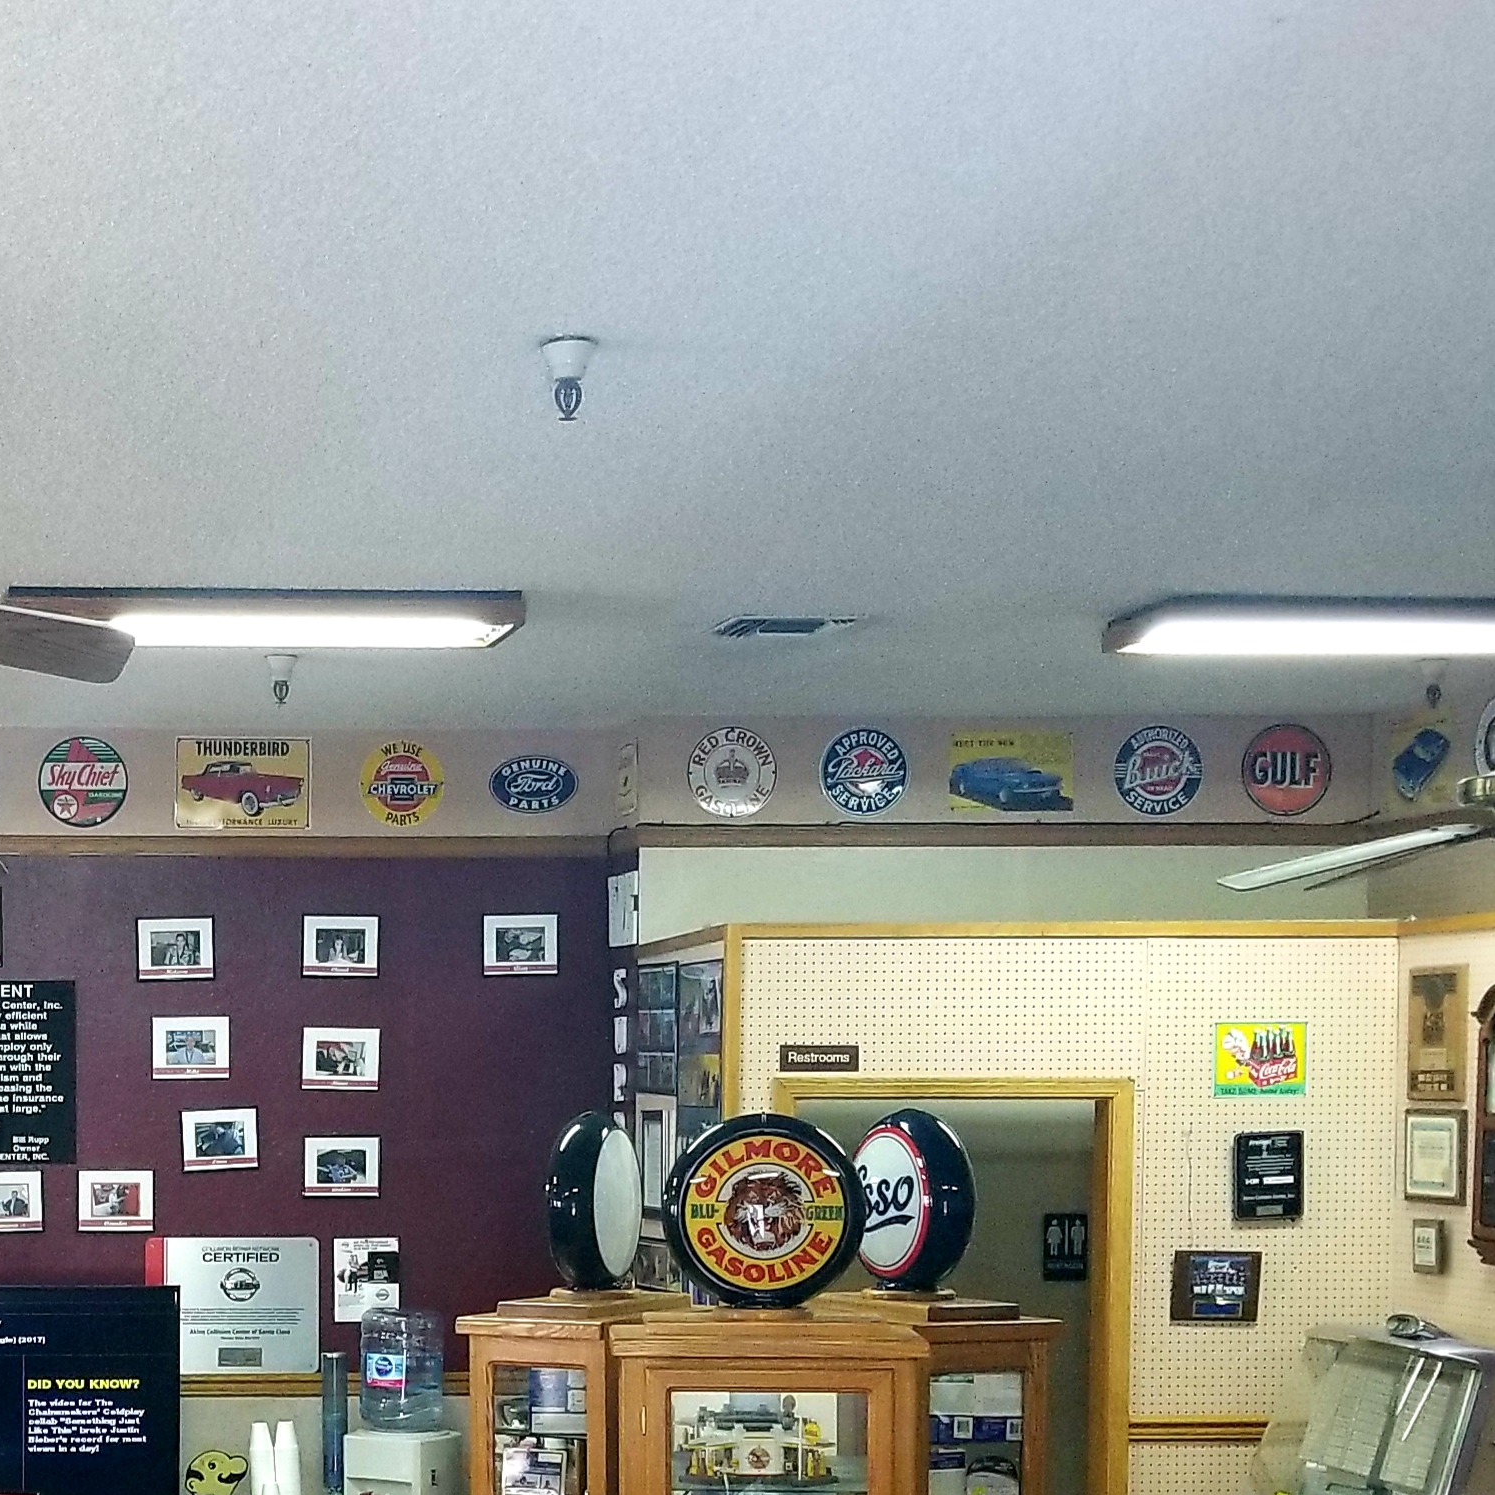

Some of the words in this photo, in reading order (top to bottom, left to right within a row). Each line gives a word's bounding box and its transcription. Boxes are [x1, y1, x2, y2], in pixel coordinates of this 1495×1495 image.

[834, 731, 900, 760] APPROVED
[1131, 727, 1189, 750] AUTHORIZED
[195, 741, 290, 757] THUNDERBIRD
[380, 743, 399, 757] WE
[401, 741, 423, 757] USE
[692, 736, 719, 767] RED
[725, 729, 773, 768] CROWN
[379, 760, 424, 774] Genuine
[501, 758, 569, 777] GENUINE
[827, 754, 905, 784] Packard
[1124, 750, 1198, 789] Buick
[1254, 751, 1320, 788] GULF
[46, 764, 74, 791] Sky
[76, 763, 120, 788] Chief
[510, 772, 558, 794] Ford
[87, 791, 124, 799] GASOLINE
[369, 783, 437, 796] CHEVROLET
[508, 796, 560, 811] PARTS
[695, 784, 771, 816] GASOLINE
[829, 783, 904, 813] SERVICE
[1125, 791, 1189, 814] SERVICE
[268, 818, 298, 826] LUXURY
[385, 811, 421, 827] PARTS
[1, 1000, 40, 1012] Center,
[5, 1011, 48, 1021] efficient
[10, 1021, 38, 1031] while
[14, 1032, 48, 1042] allows
[30, 1042, 54, 1054] only
[37, 1053, 62, 1063] their
[788, 1051, 850, 1064] Restrooms
[9, 1063, 32, 1073] with
[35, 1063, 52, 1073] the
[28, 1136, 50, 1145] Rupp
[32, 1153, 50, 1162] INC.
[693, 1139, 838, 1199] GILMORE
[690, 1203, 720, 1220] BLU-
[805, 1203, 845, 1221] GREEN
[202, 1252, 280, 1263] CERTIFIED
[696, 1227, 834, 1284] GASOLINE
[18, 1336, 46, 1345] (2017)
[27, 1379, 52, 1390] DID
[55, 1379, 85, 1390] YOU
[89, 1379, 140, 1390] KNOW?
